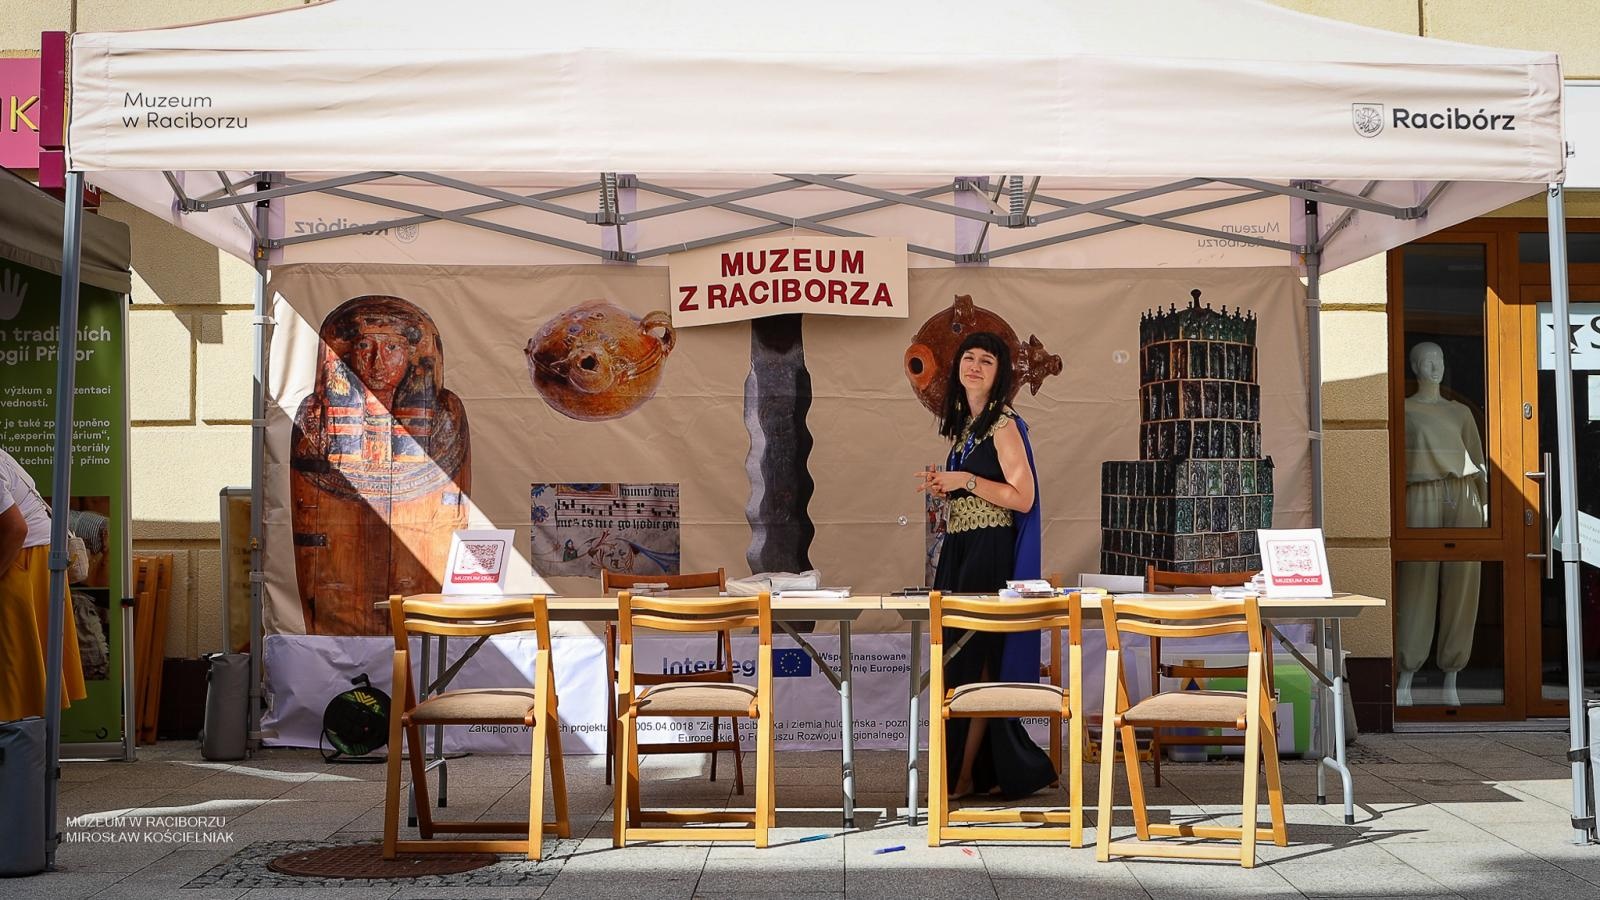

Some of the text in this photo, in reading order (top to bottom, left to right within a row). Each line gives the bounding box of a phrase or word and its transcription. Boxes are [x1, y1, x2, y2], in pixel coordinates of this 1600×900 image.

[123, 92, 212, 108] Muzeum
[122, 112, 248, 129] w Raciborzu
[1392, 107, 1515, 131] Racibórz
[721, 248, 864, 277] MUZEUM
[679, 279, 894, 311] Z RACIBORZA
[13, 326, 111, 342] tradiních
[4, 386, 42, 396] výzkum
[4, 418, 15, 429] je
[18, 419, 41, 428] také
[80, 456, 111, 466] přímo
[468, 724, 519, 734] Zakupiono
[791, 718, 822, 729] ziemia
[797, 730, 837, 742] Rozwoju
